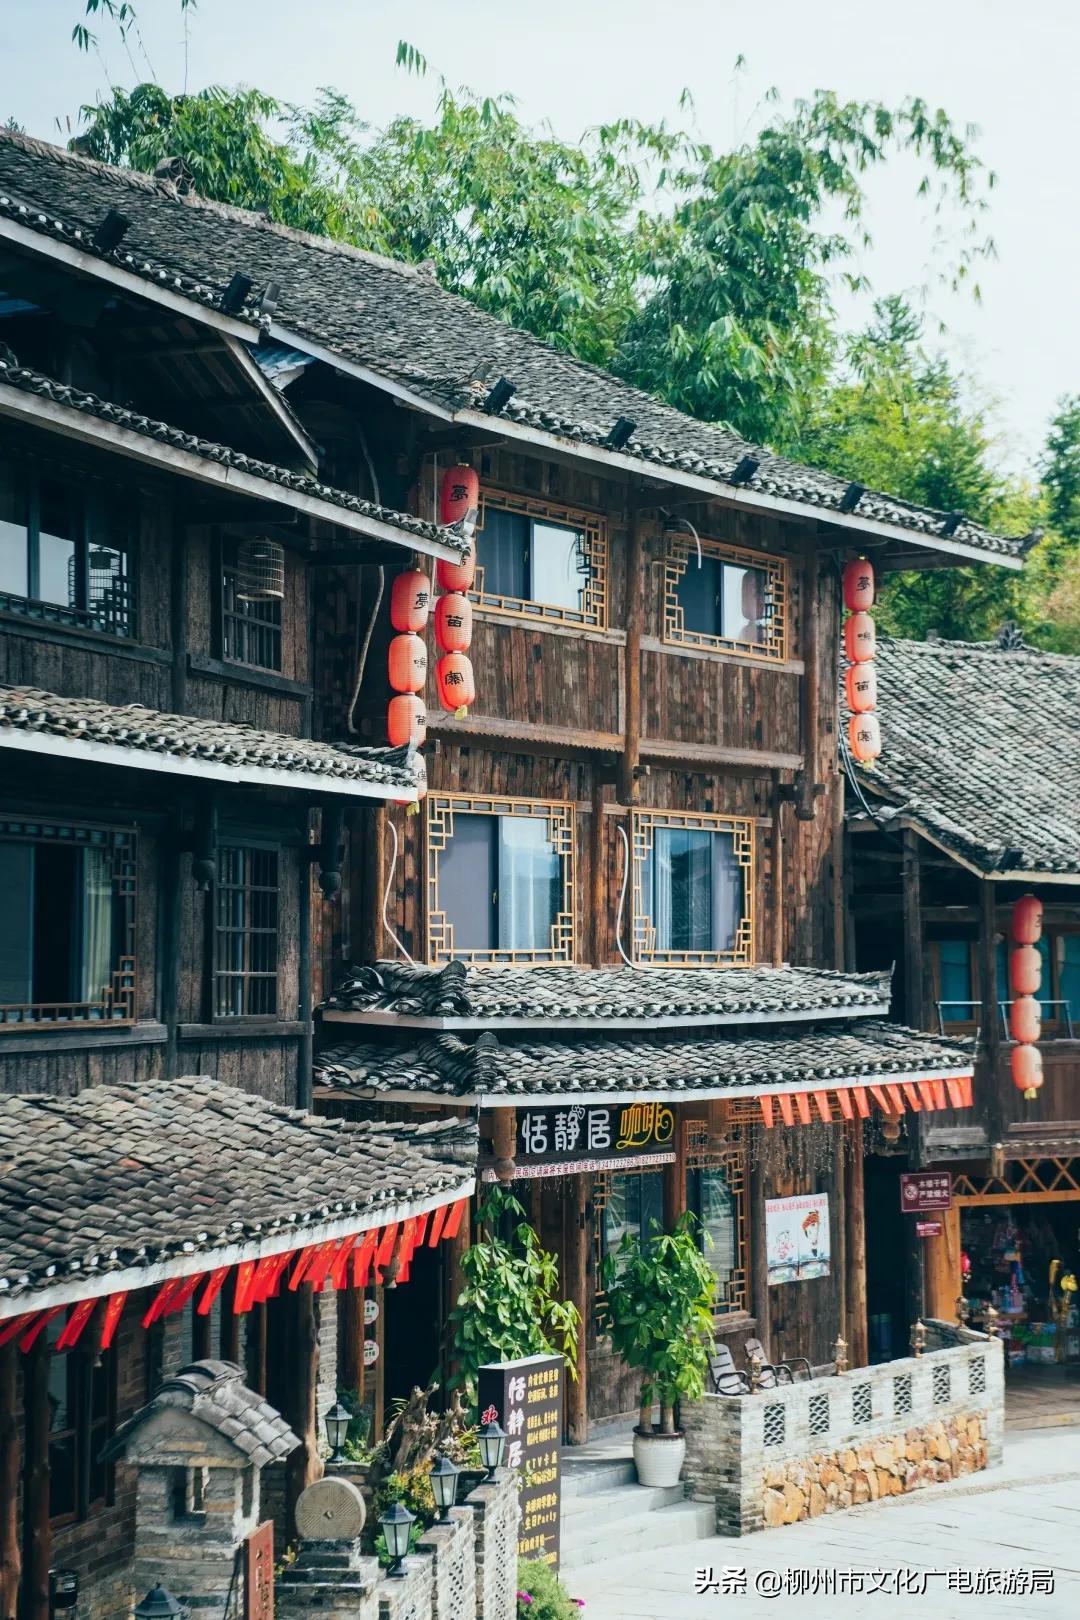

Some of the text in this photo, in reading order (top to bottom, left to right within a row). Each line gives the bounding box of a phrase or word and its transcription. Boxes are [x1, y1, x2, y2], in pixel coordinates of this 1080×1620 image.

[521, 1100, 675, 1154] 恬静居 咖啡
